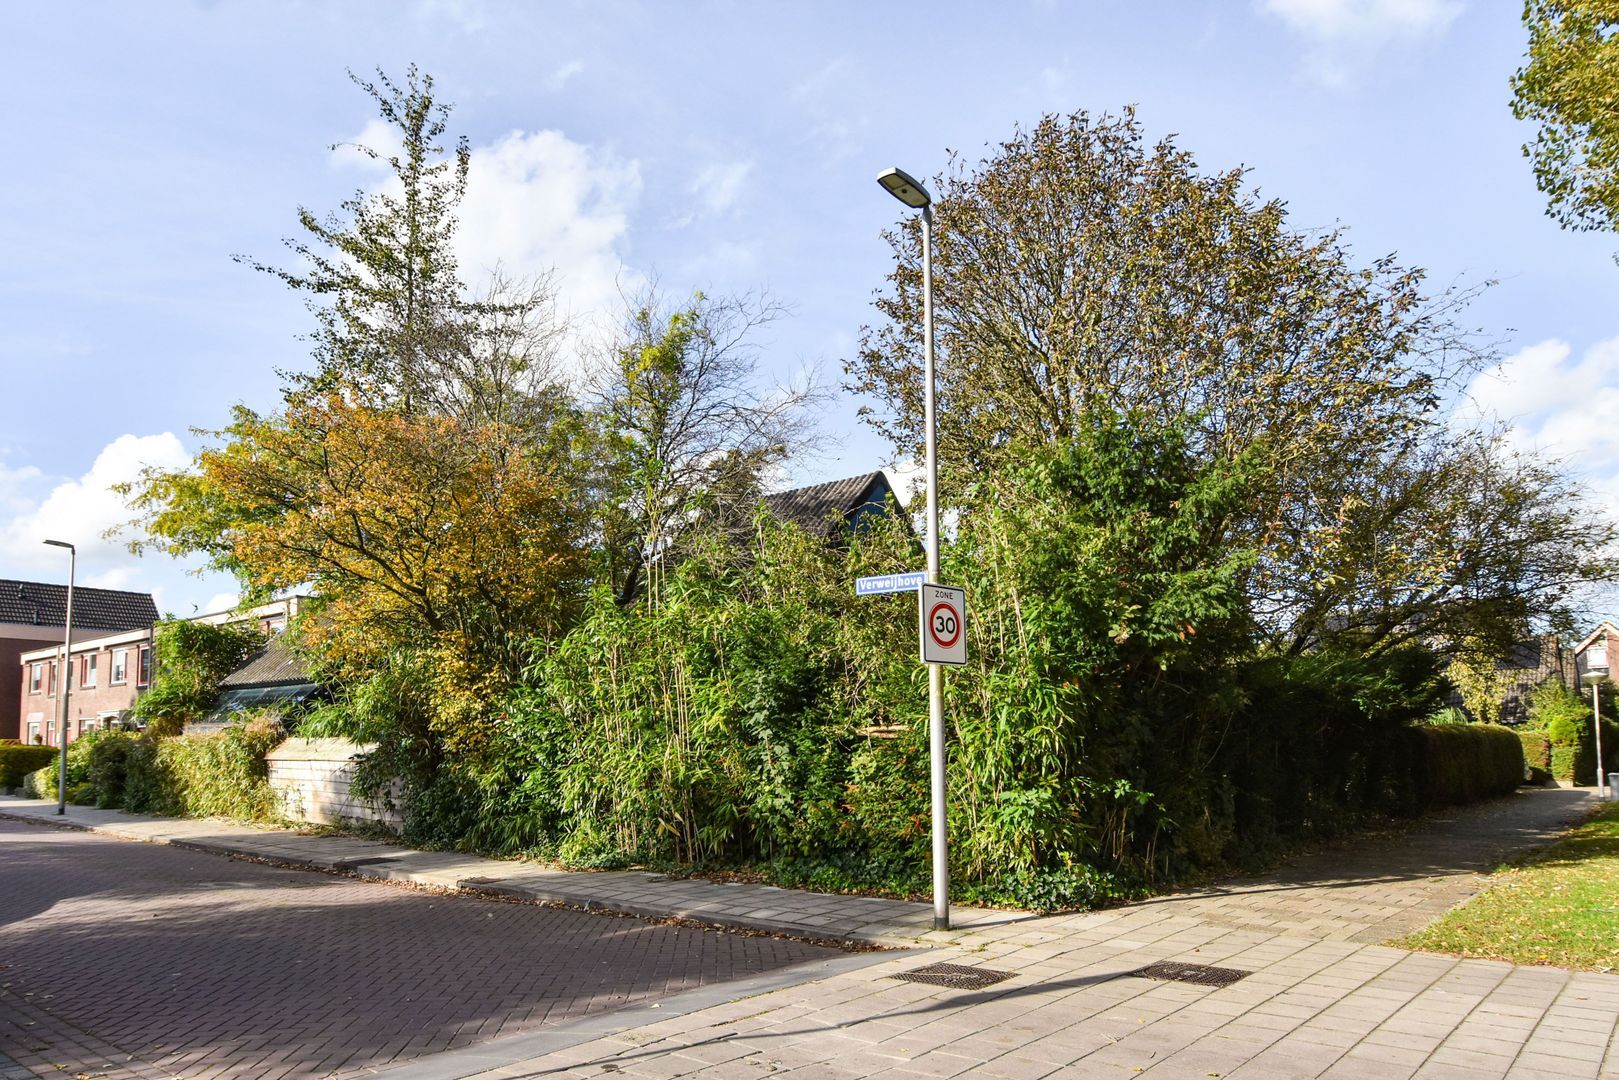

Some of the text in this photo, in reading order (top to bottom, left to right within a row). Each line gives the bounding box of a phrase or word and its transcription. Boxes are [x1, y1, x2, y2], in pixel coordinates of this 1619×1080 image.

[860, 575, 923, 590] Verweijhove
[935, 590, 954, 600] ZONE
[935, 615, 956, 635] 30
